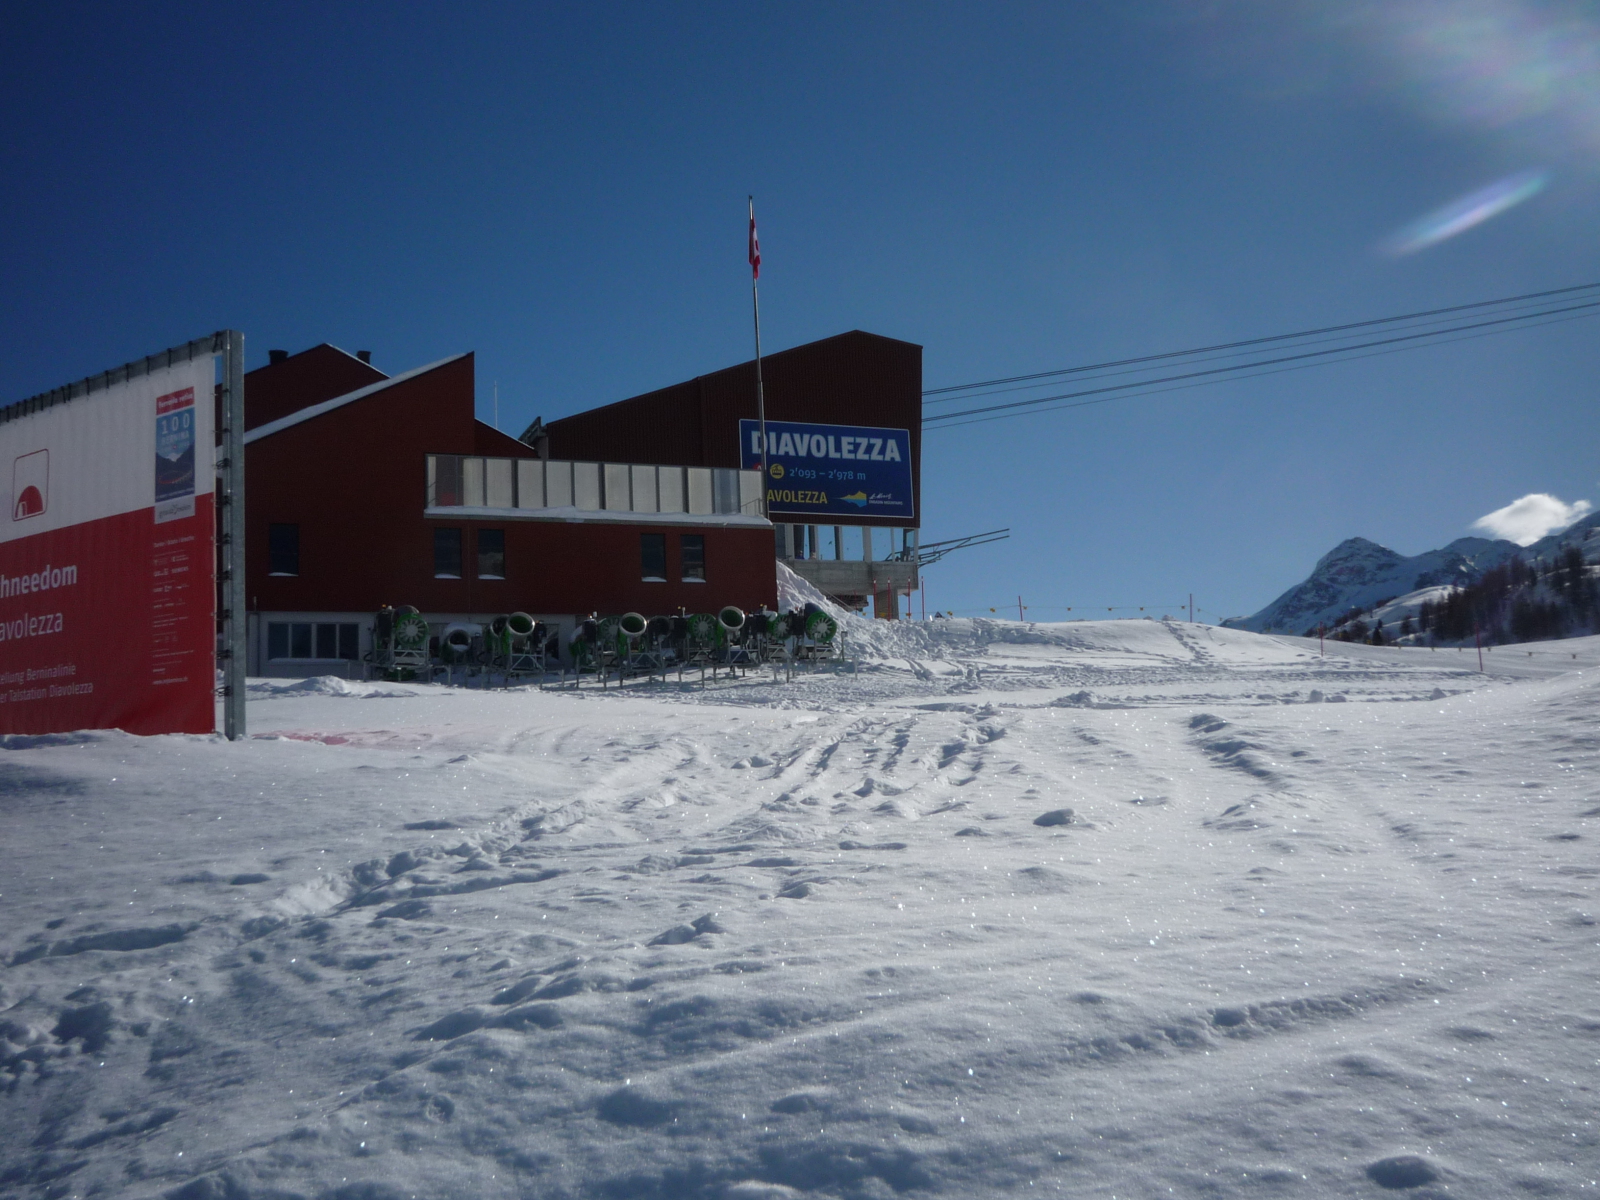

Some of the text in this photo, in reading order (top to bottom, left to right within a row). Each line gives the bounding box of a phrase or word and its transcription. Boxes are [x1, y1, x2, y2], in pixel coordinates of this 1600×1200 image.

[751, 430, 902, 462] DIAVOLEZZA
[857, 472, 866, 480] m
[767, 489, 828, 504] AVOLEZZA
[0, 564, 77, 599] hneedom
[0, 612, 63, 641] avolezza
[49, 681, 94, 698] Diavolezza
